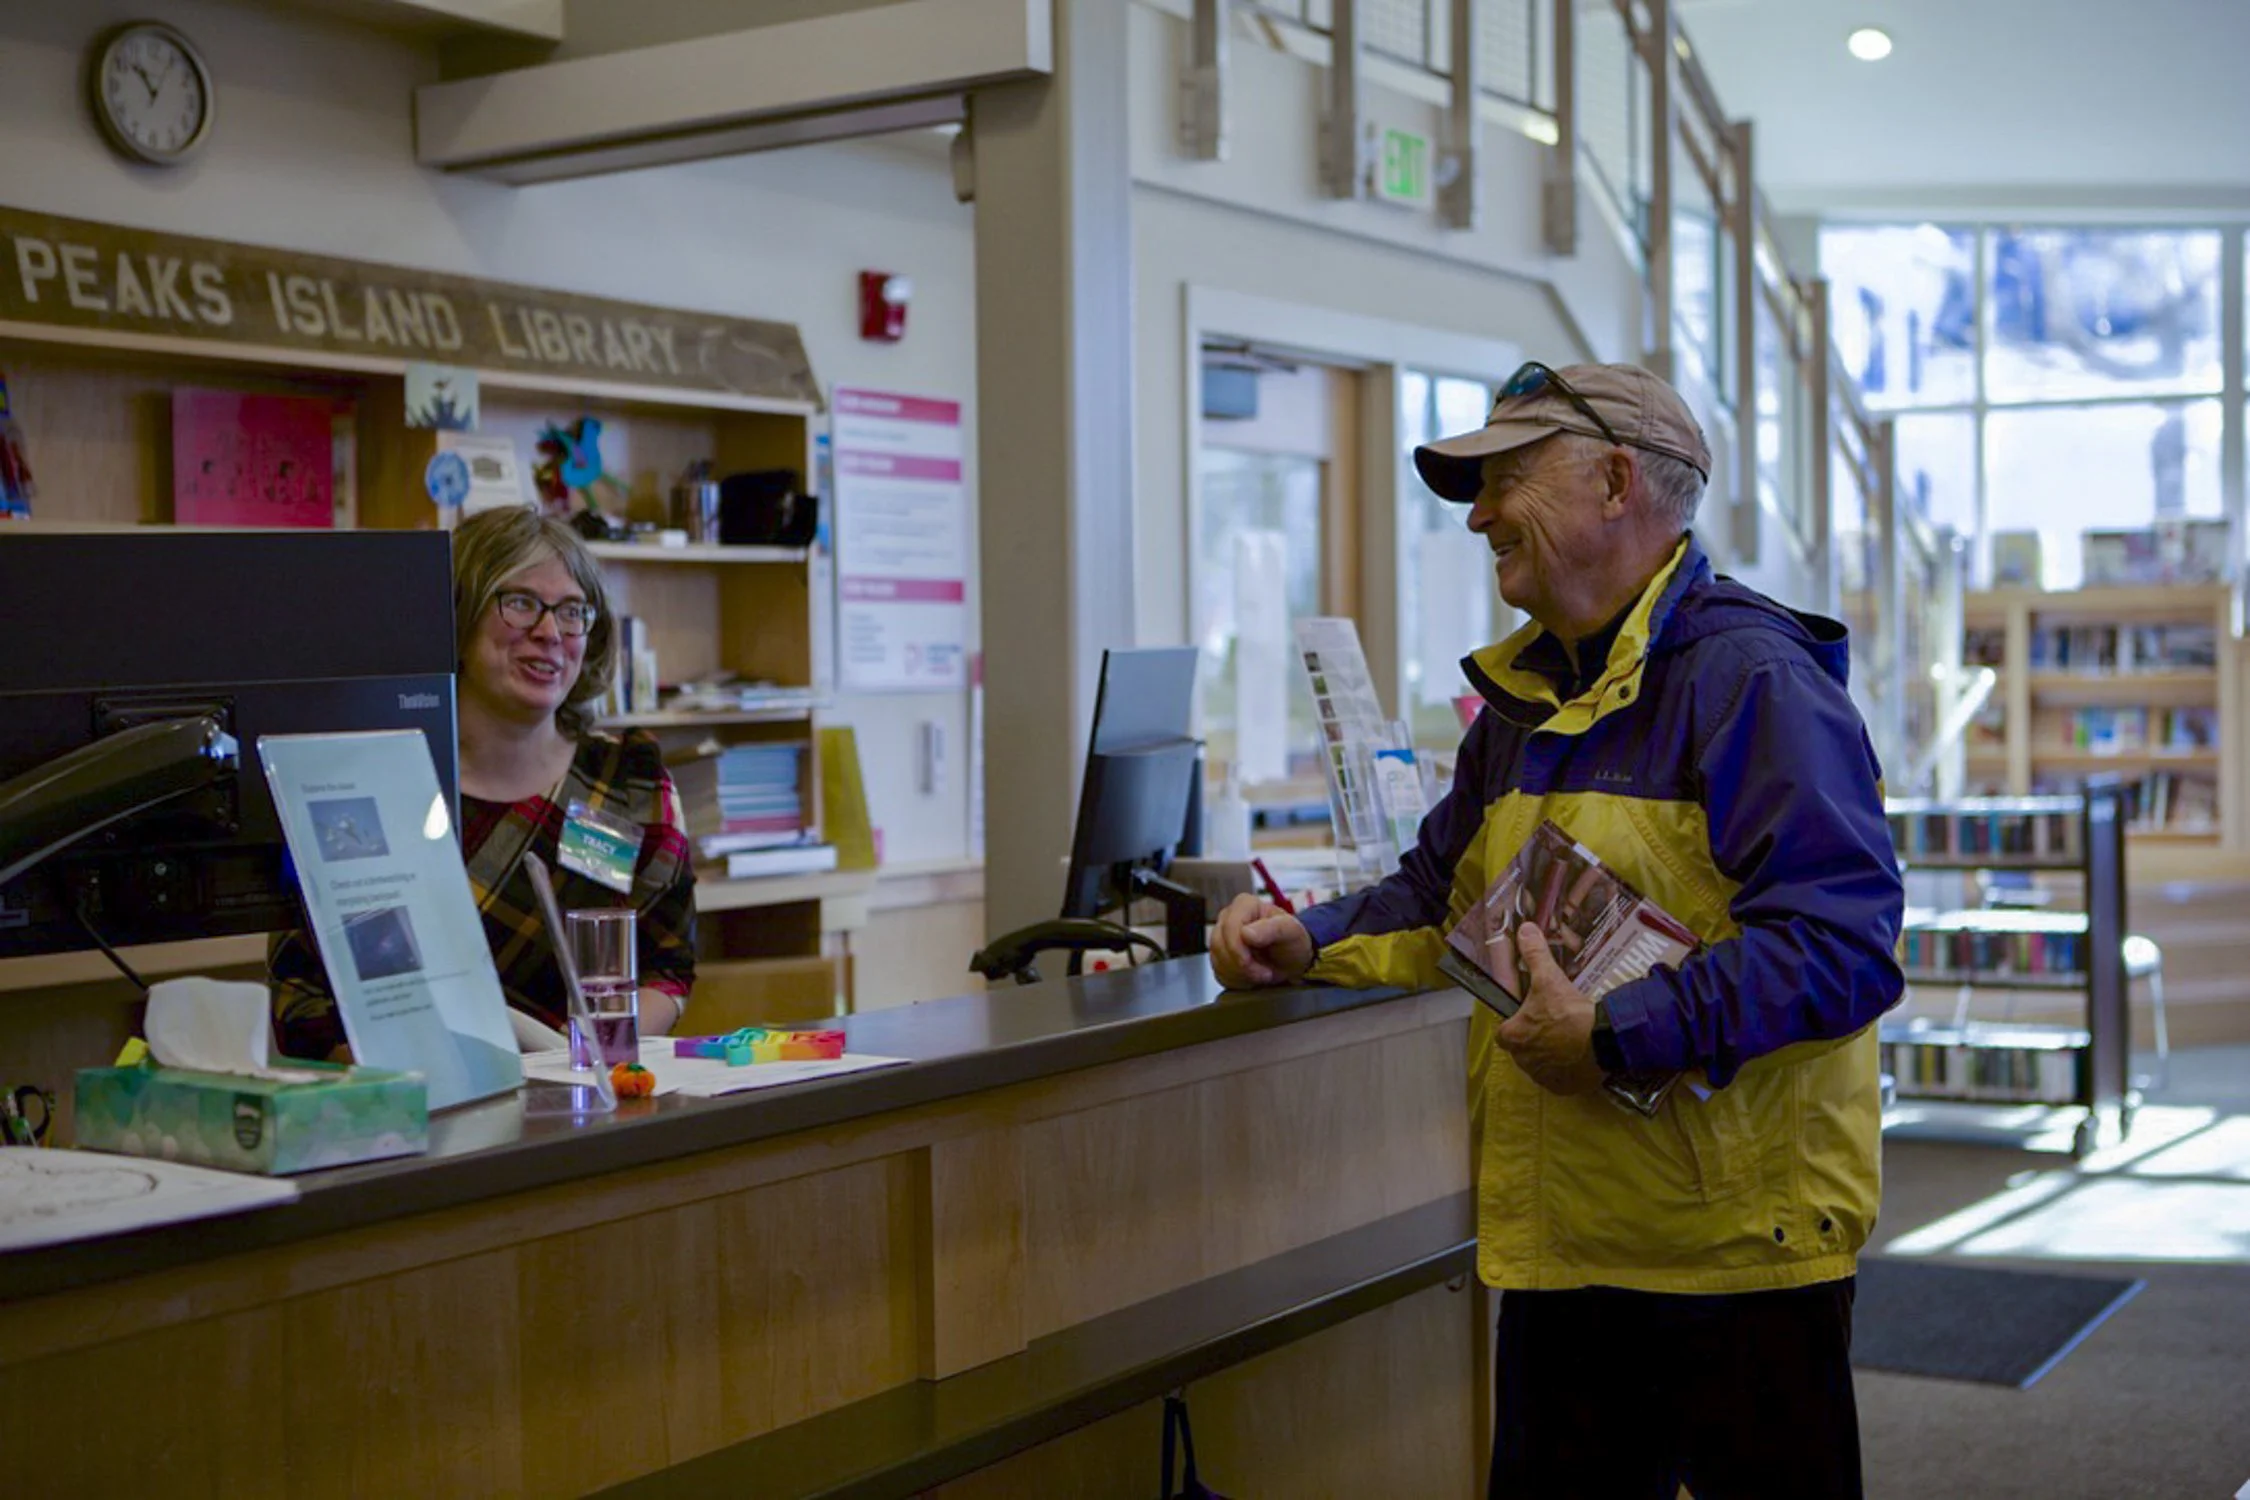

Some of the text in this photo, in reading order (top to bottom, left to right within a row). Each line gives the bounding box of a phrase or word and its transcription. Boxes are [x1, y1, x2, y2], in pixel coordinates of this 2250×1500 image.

[13, 236, 680, 374] PEAKS ISLAND LIBRARY
